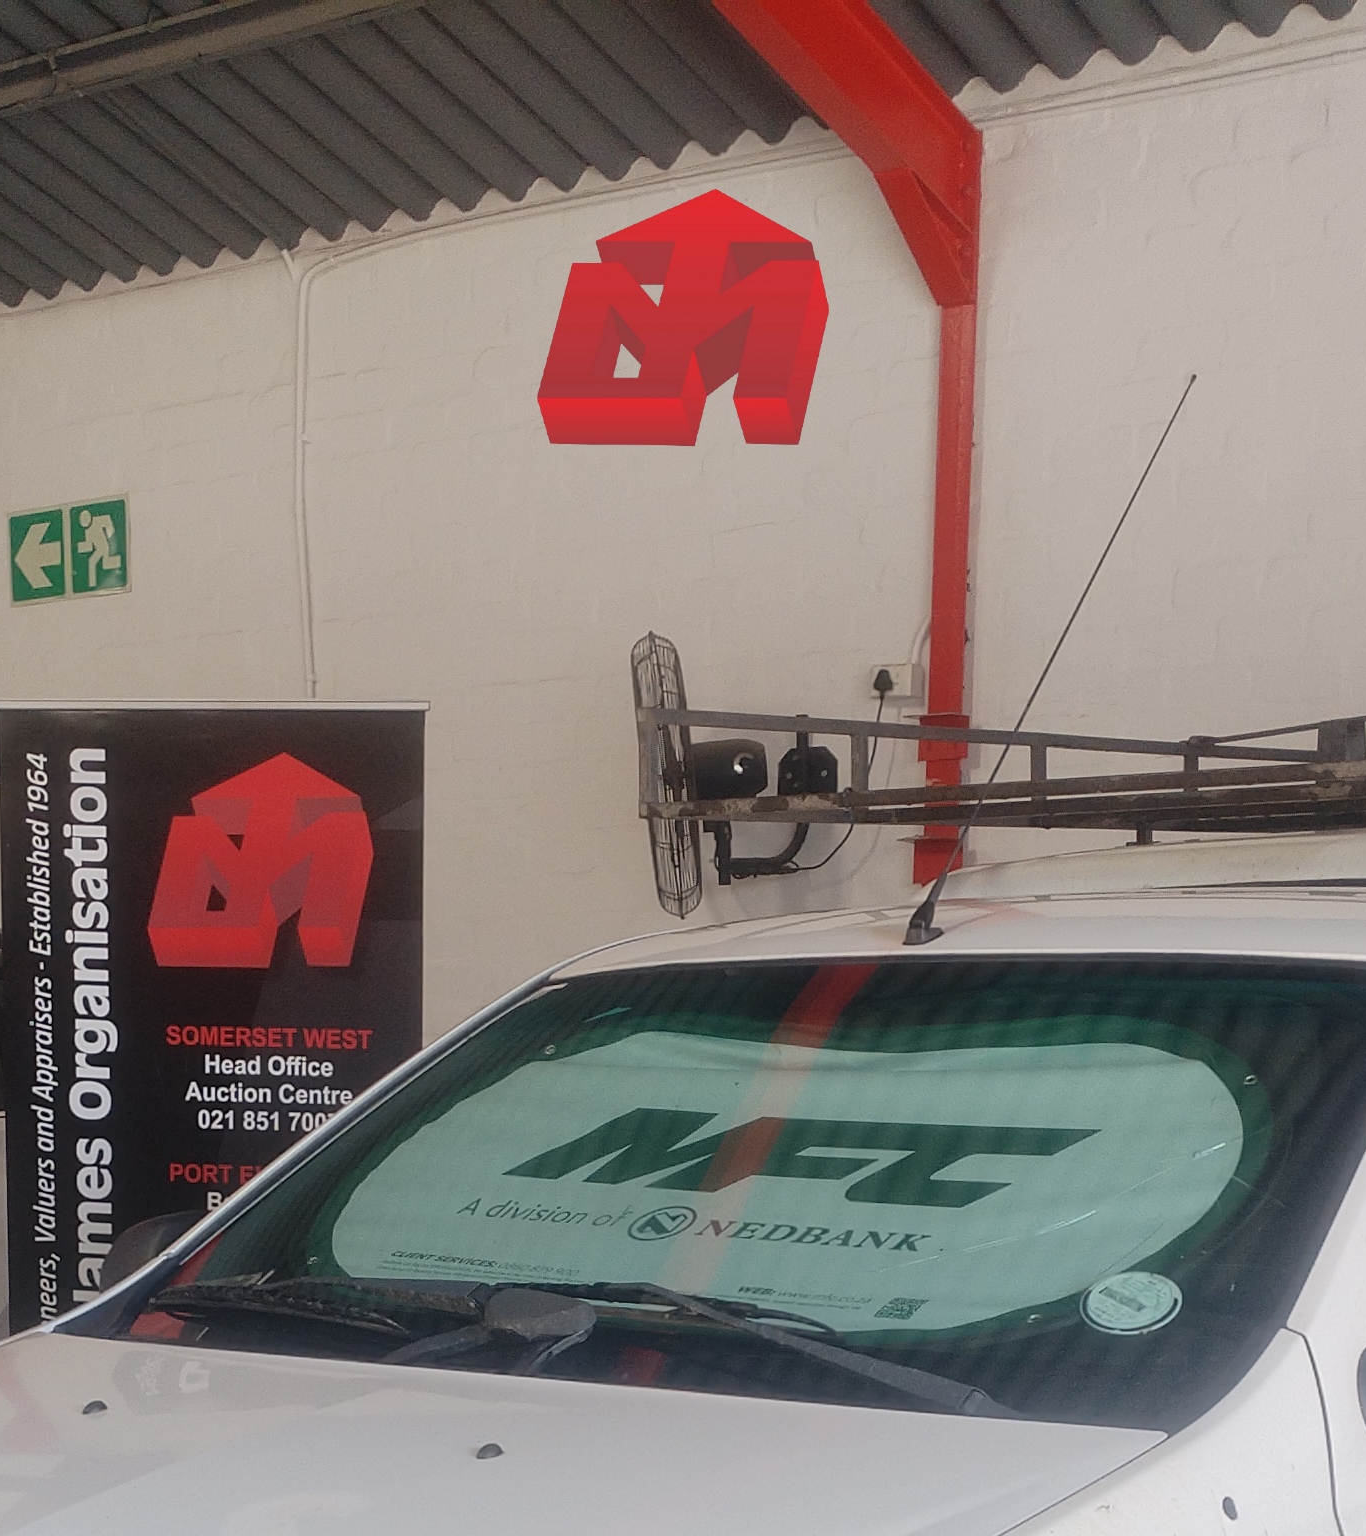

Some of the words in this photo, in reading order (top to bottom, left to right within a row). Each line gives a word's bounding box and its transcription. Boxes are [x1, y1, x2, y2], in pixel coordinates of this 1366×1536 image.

[25, 752, 48, 812] 1964
[26, 815, 53, 957] Established
[61, 747, 118, 1121] Organisation
[29, 978, 55, 1103] Appraisers
[165, 1026, 297, 1048] SOMERSET
[302, 1029, 373, 1050] WEST
[204, 1054, 261, 1076] Head
[267, 1056, 334, 1078] Office
[185, 1081, 272, 1103] Auction
[278, 1084, 353, 1105] Centre
[31, 1105, 56, 1155] and
[197, 1109, 235, 1130] 021
[242, 1111, 280, 1131] 851
[288, 1112, 335, 1132] 700
[168, 1162, 233, 1184] PORT
[502, 1107, 1102, 1209] MFC
[32, 1161, 56, 1242] Valuers
[457, 1196, 483, 1217] A
[486, 1199, 587, 1227] division
[591, 1206, 633, 1229] of
[693, 1219, 933, 1253] NEDBANK
